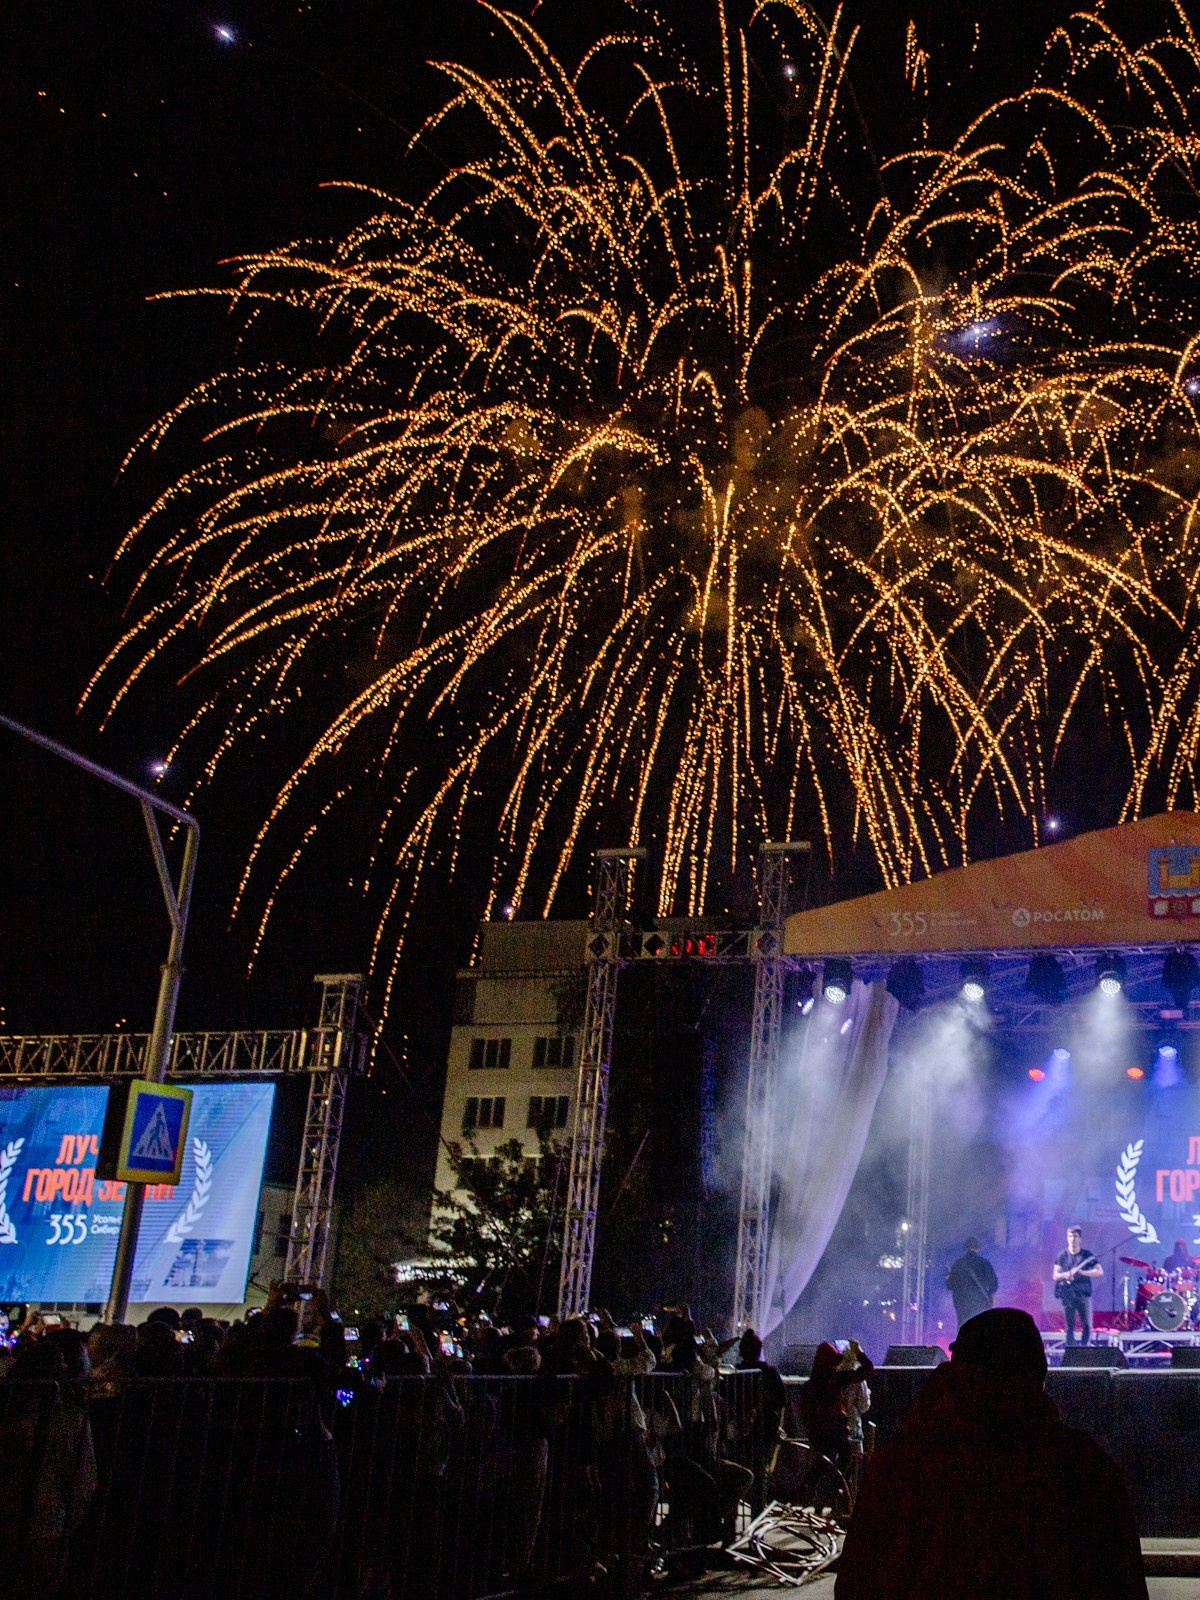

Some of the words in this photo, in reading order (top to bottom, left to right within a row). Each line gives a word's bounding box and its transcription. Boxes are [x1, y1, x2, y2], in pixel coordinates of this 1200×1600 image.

[890, 911, 928, 937] 355
[1033, 908, 1105, 922] РОСАТОМ
[55, 1134, 99, 1165] ЛУЧ
[22, 1168, 95, 1206] ГОРОД
[46, 1214, 87, 1245] 355
[91, 1224, 120, 1236] Сибир
